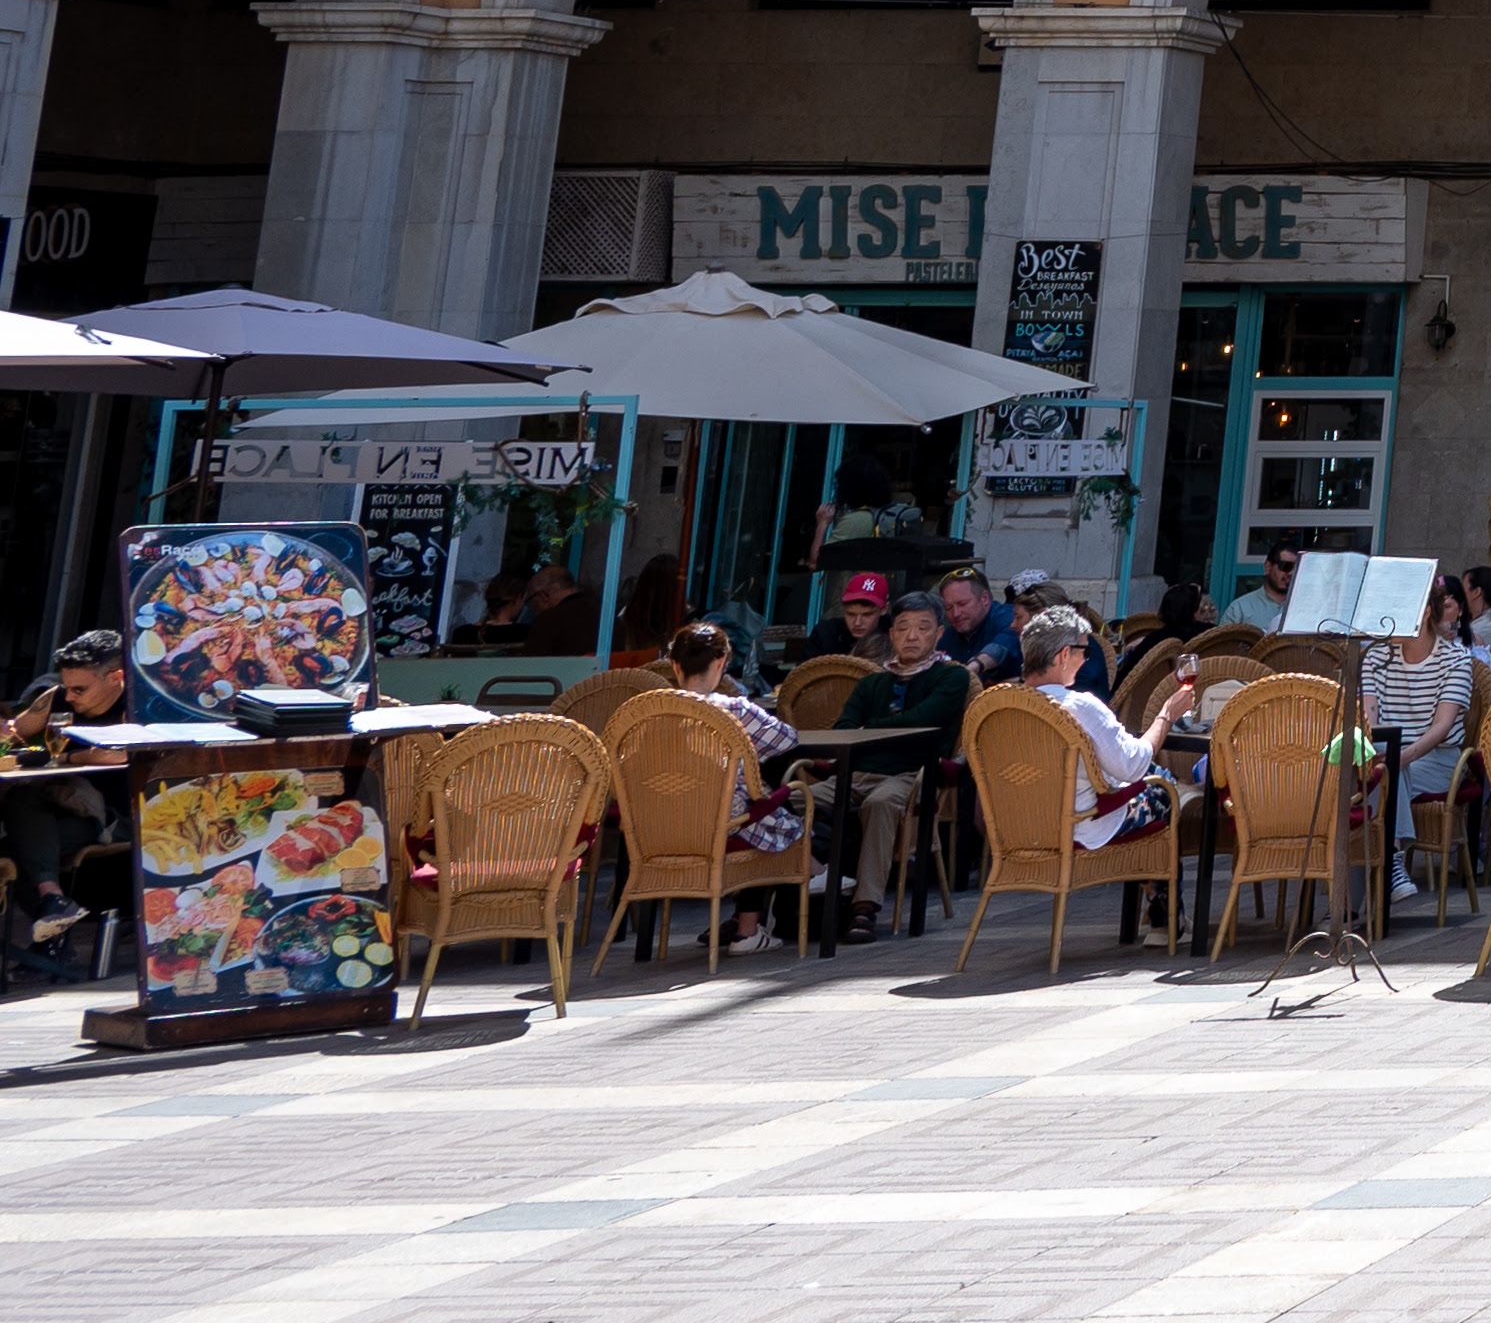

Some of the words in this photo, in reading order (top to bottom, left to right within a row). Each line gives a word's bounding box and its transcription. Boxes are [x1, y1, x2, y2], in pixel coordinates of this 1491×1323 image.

[757, 185, 944, 259] MISE
[1017, 243, 1086, 278] Best
[1036, 271, 1095, 282] BREAKFAST
[1041, 310, 1084, 320] TOWN
[1015, 323, 1085, 337] BOWLS
[416, 493, 443, 505] OPEN
[370, 508, 389, 520] FOR
[393, 507, 446, 519] BREAKFAST
[862, 578, 877, 592] NY
